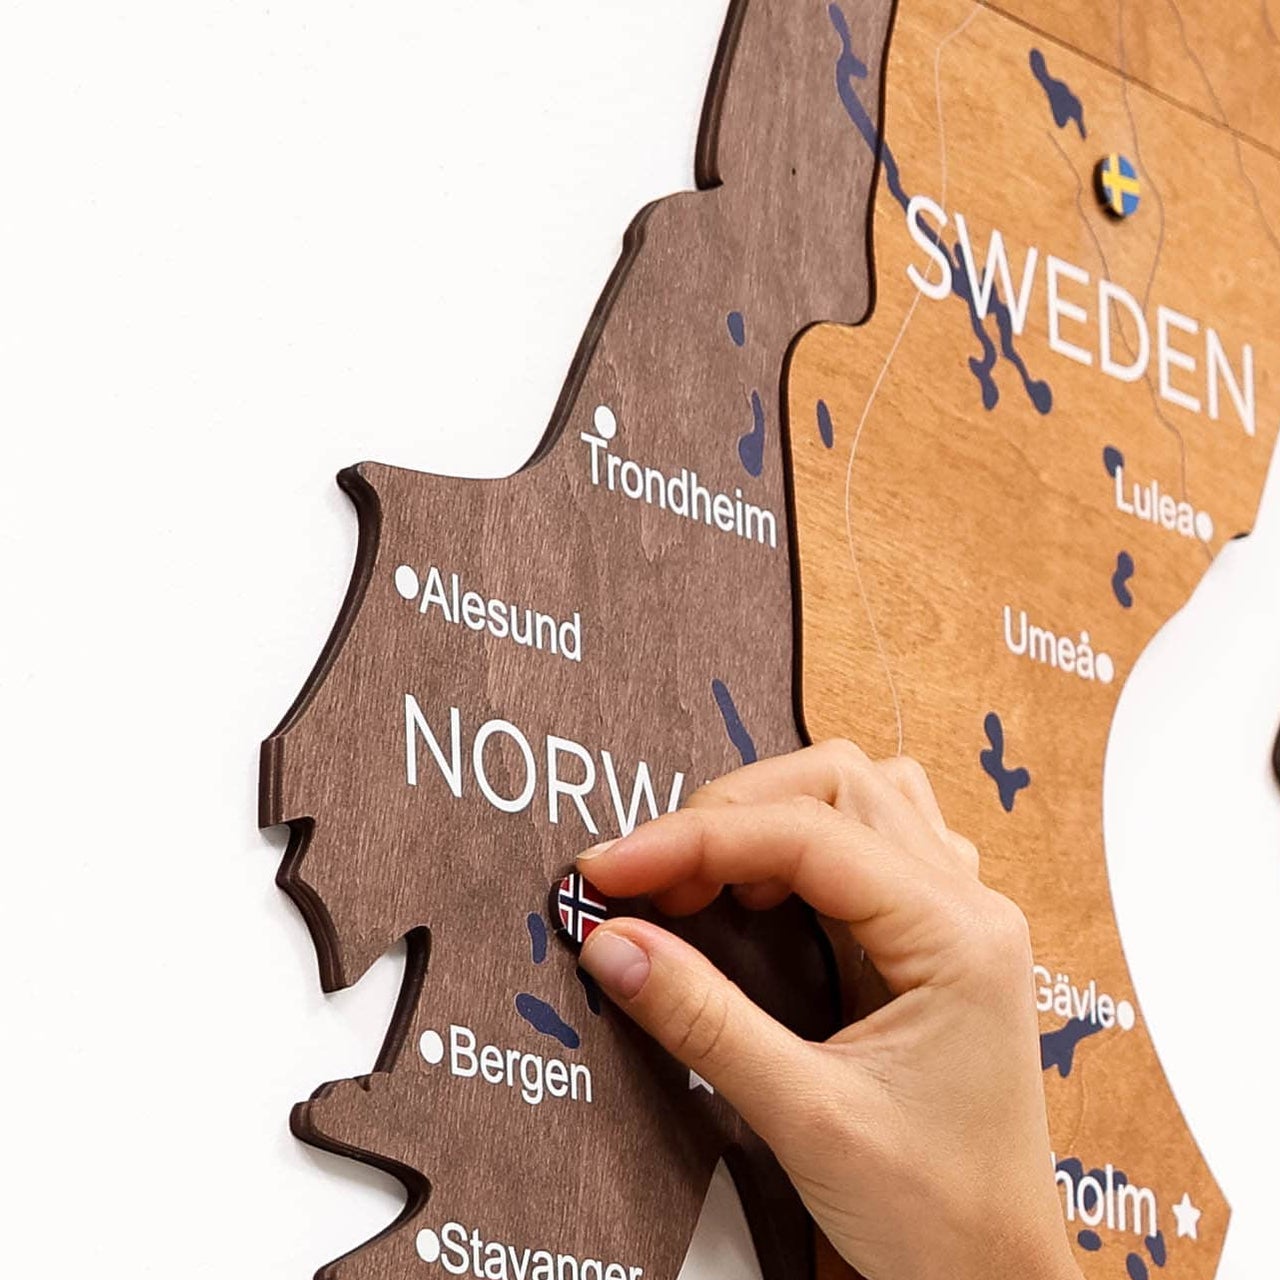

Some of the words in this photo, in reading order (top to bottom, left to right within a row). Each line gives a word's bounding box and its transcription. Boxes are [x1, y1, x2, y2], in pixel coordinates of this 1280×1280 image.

[906, 195, 1256, 437] SWEDEN
[580, 432, 776, 549] Trondheim
[1115, 465, 1195, 538] Lulea
[419, 566, 581, 662] Alesund
[1003, 604, 1094, 682] Umeå
[405, 693, 686, 838] NORW
[1031, 964, 1116, 1029] Gävle
[450, 1024, 593, 1105] Bergen
